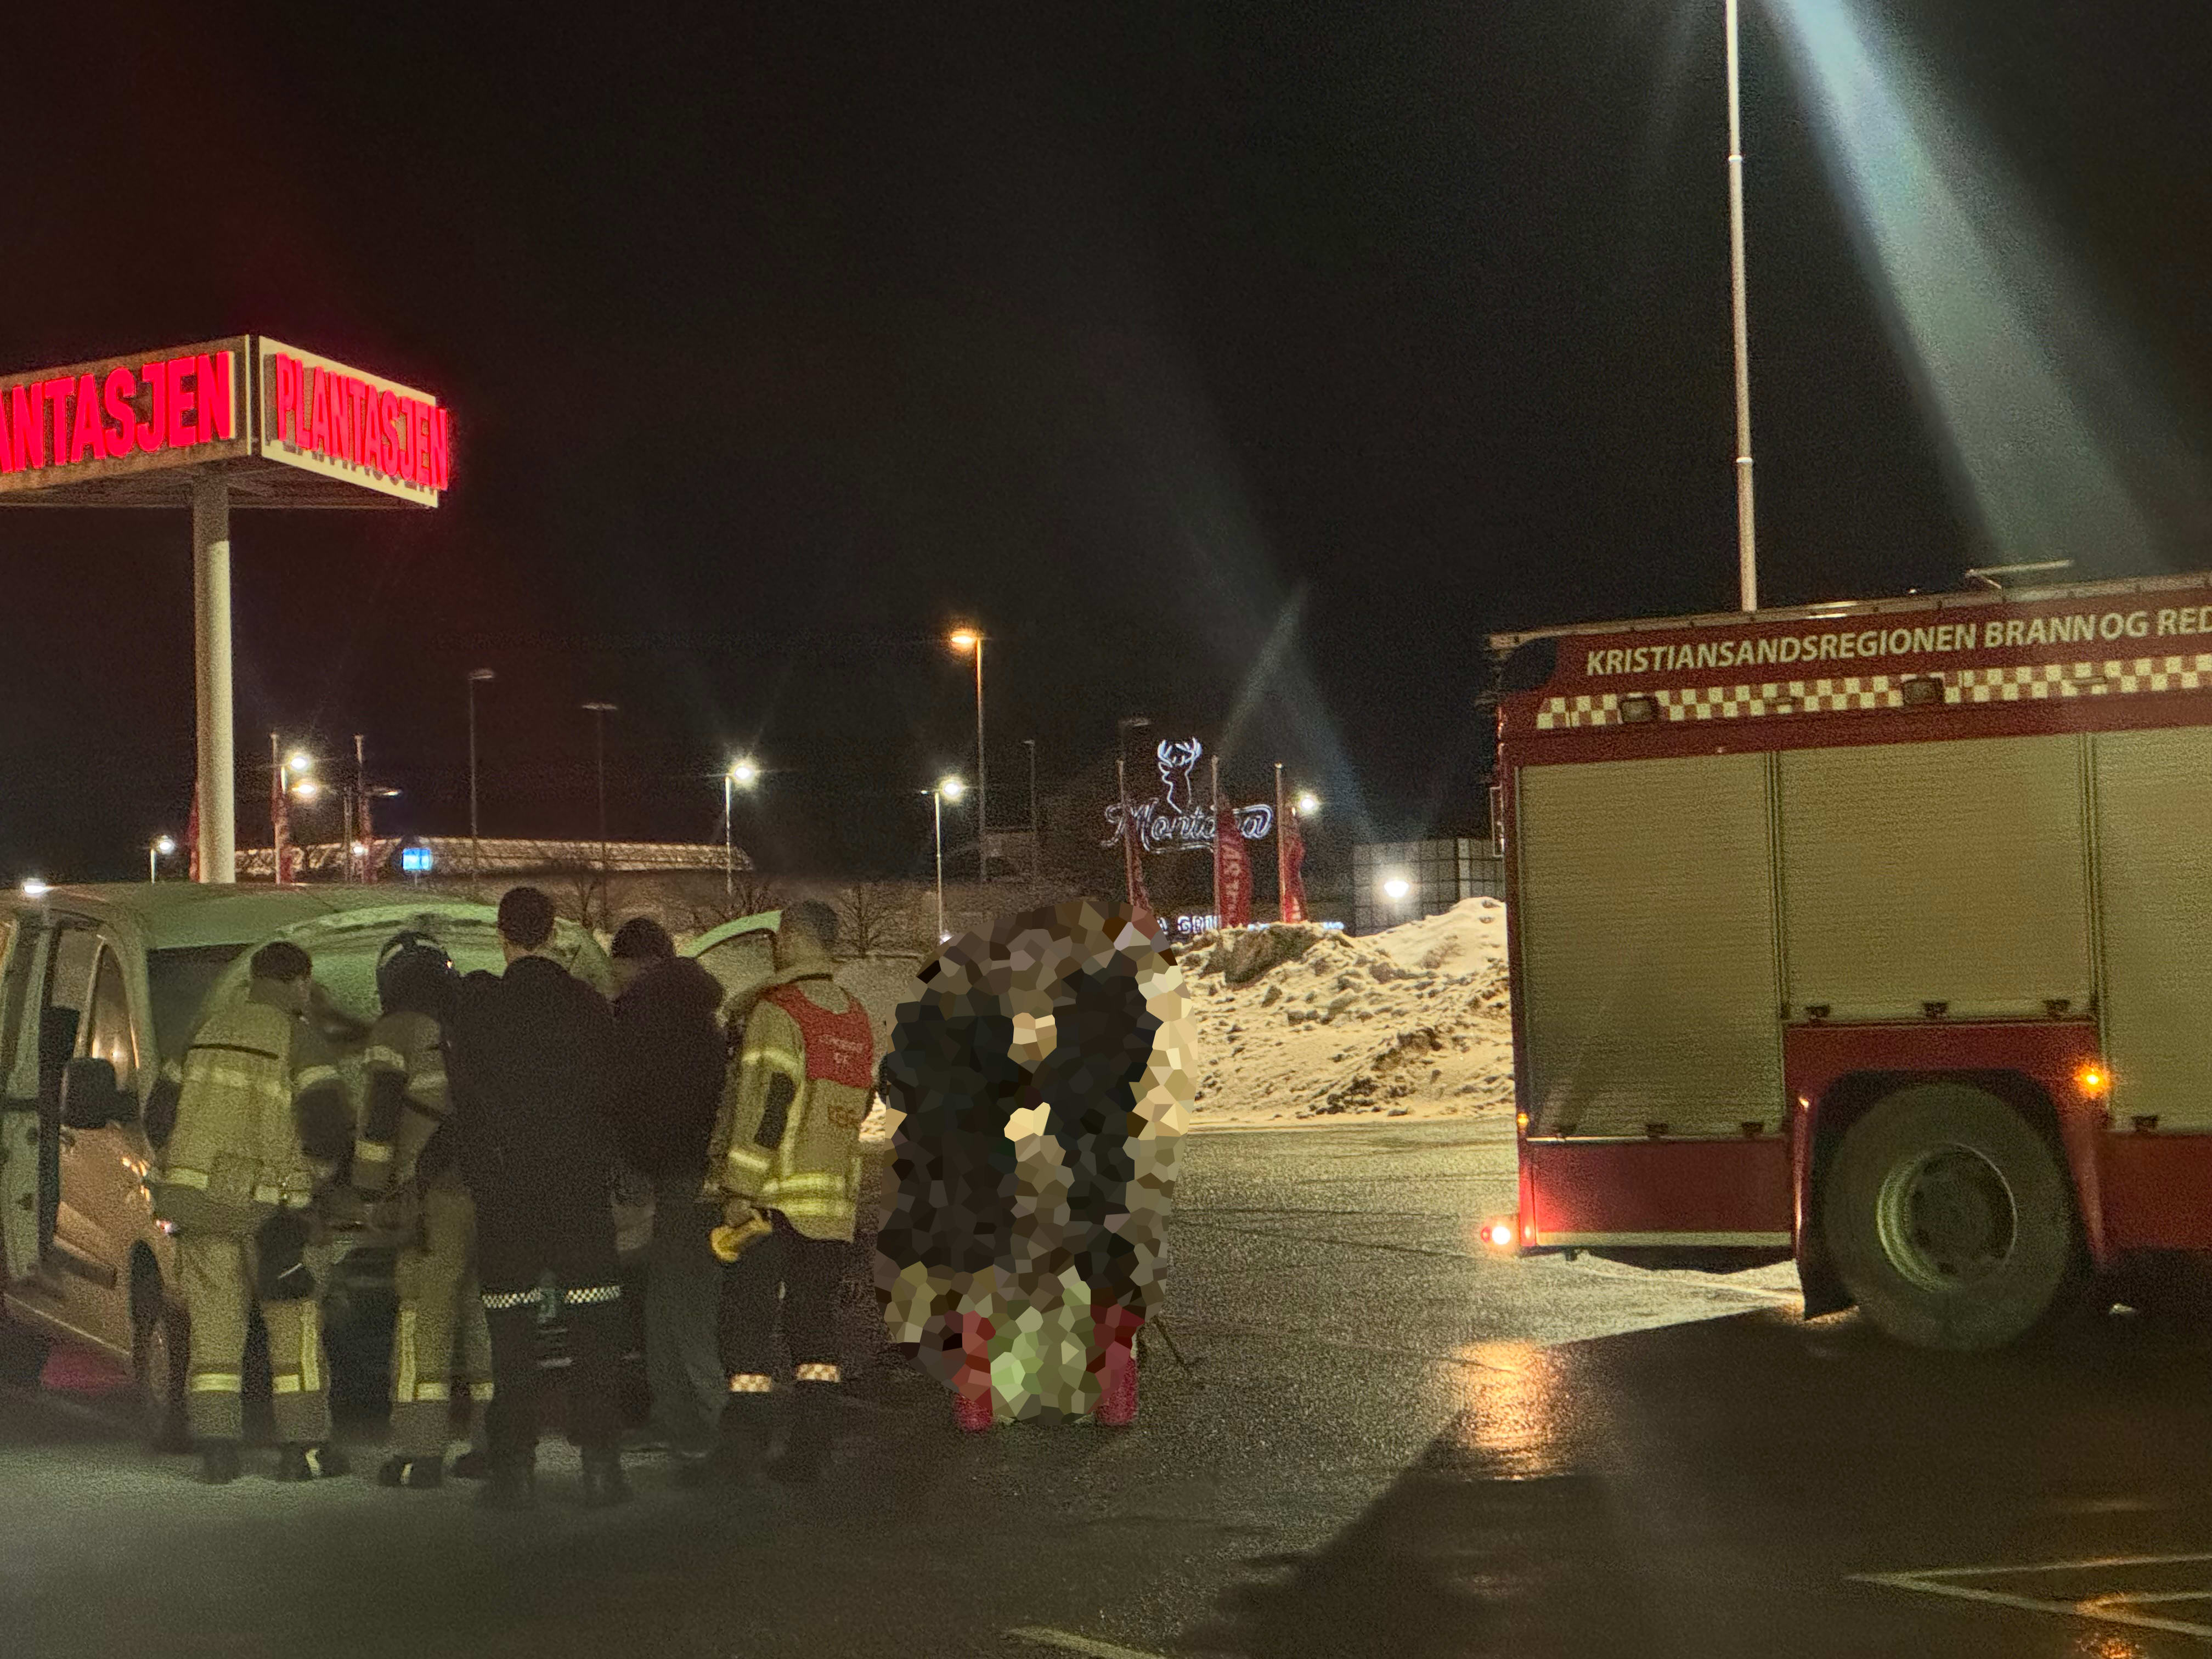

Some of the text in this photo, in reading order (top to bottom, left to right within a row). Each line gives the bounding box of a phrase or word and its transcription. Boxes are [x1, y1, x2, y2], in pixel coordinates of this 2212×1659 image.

[276, 352, 448, 490] PLANTASJEN
[1587, 623, 1974, 676] KRISTIANSANDSREGIONEN
[1983, 613, 2096, 648] BRANN
[2099, 611, 2148, 640] OG
